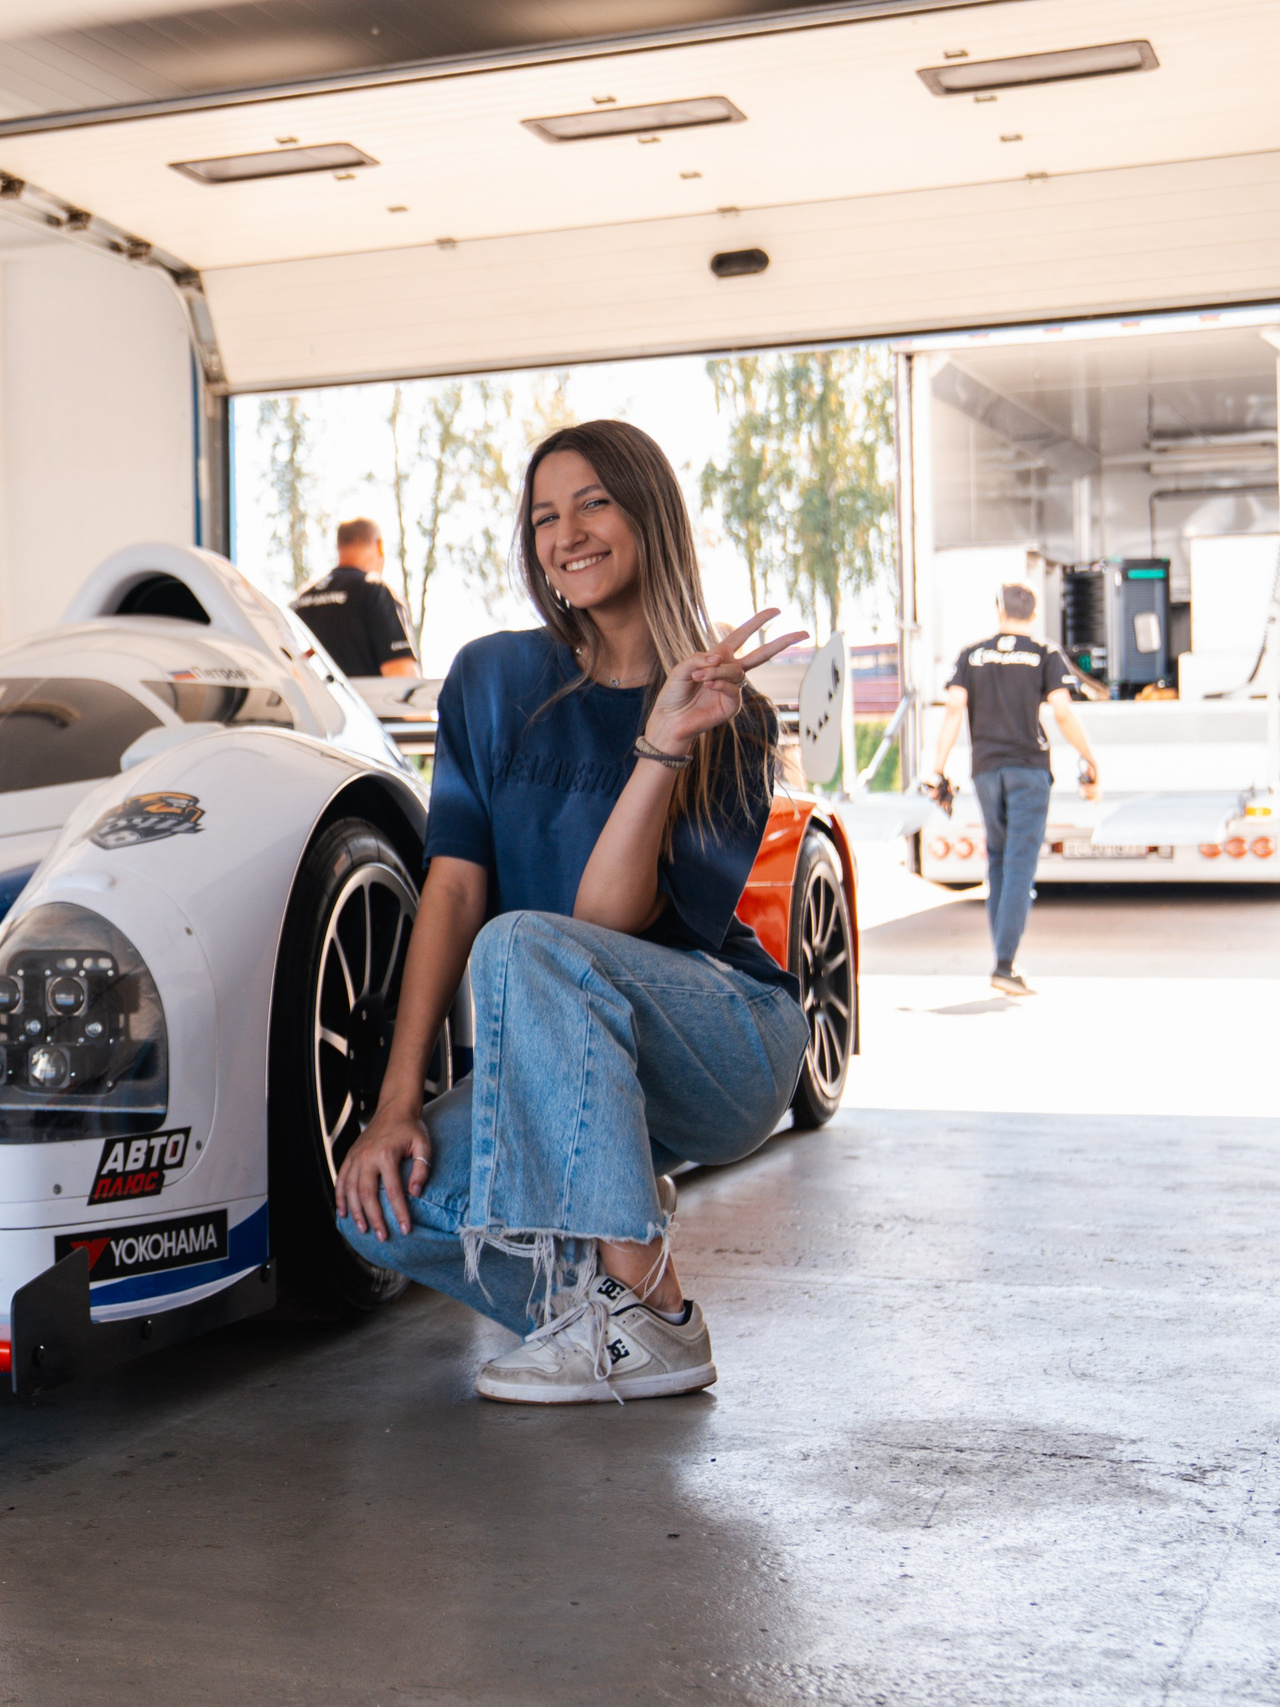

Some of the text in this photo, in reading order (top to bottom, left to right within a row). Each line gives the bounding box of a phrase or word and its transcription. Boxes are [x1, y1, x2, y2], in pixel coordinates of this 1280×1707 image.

[100, 1133, 186, 1175] АВТО
[93, 1171, 159, 1200] ПЛЮС
[110, 1223, 218, 1267] YOKOHAMA
